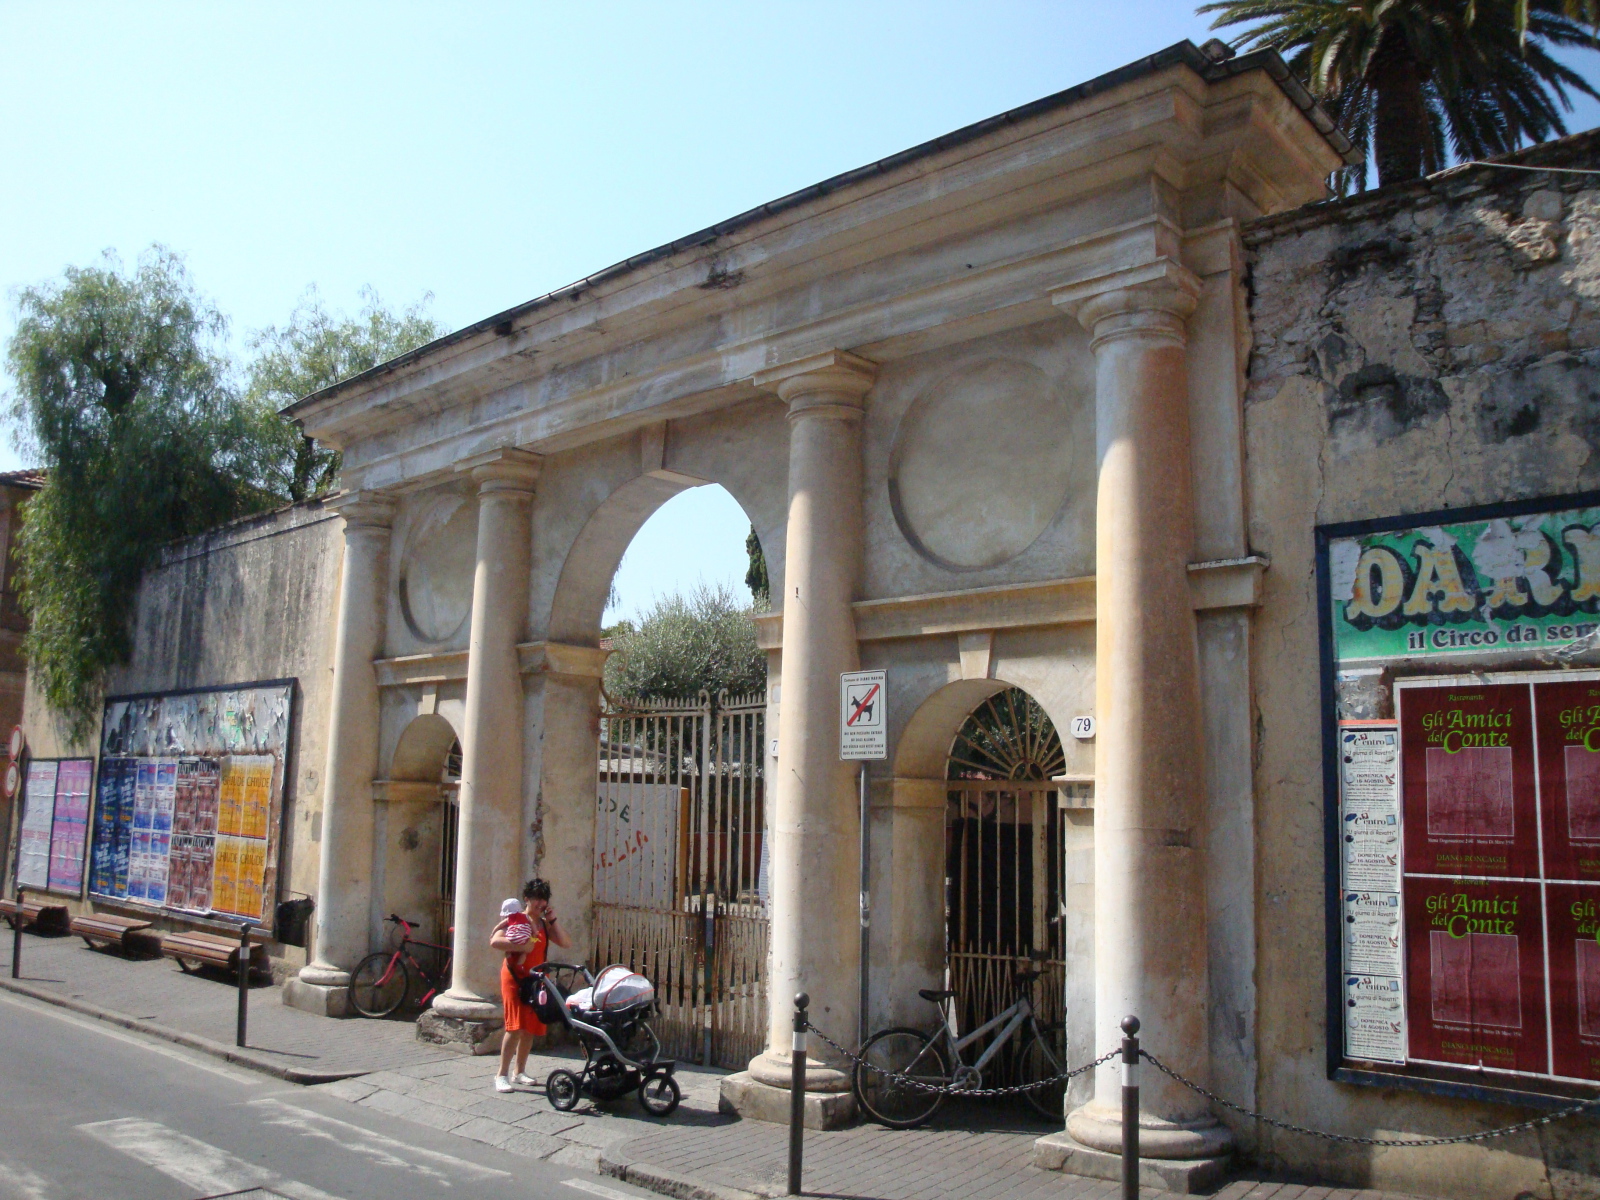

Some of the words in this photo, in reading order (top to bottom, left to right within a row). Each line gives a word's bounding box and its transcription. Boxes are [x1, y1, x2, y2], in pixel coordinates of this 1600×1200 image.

[1409, 632, 1425, 650] il
[1432, 628, 1498, 648] Circo
[1506, 624, 1537, 643] da
[1076, 718, 1092, 732] 79
[1422, 710, 1444, 731] Gli
[1446, 708, 1513, 729] Amici
[1560, 706, 1583, 728] Gli
[1427, 730, 1445, 742] del
[1443, 730, 1509, 754] Conte
[1566, 726, 1586, 739] del
[246, 776, 270, 788] CHIUDE
[1425, 893, 1448, 913] Gli
[1451, 894, 1519, 915] Amici
[1570, 898, 1596, 921] Gli
[1432, 912, 1449, 926] del
[1448, 915, 1515, 939] Conte
[1577, 919, 1597, 934] del
